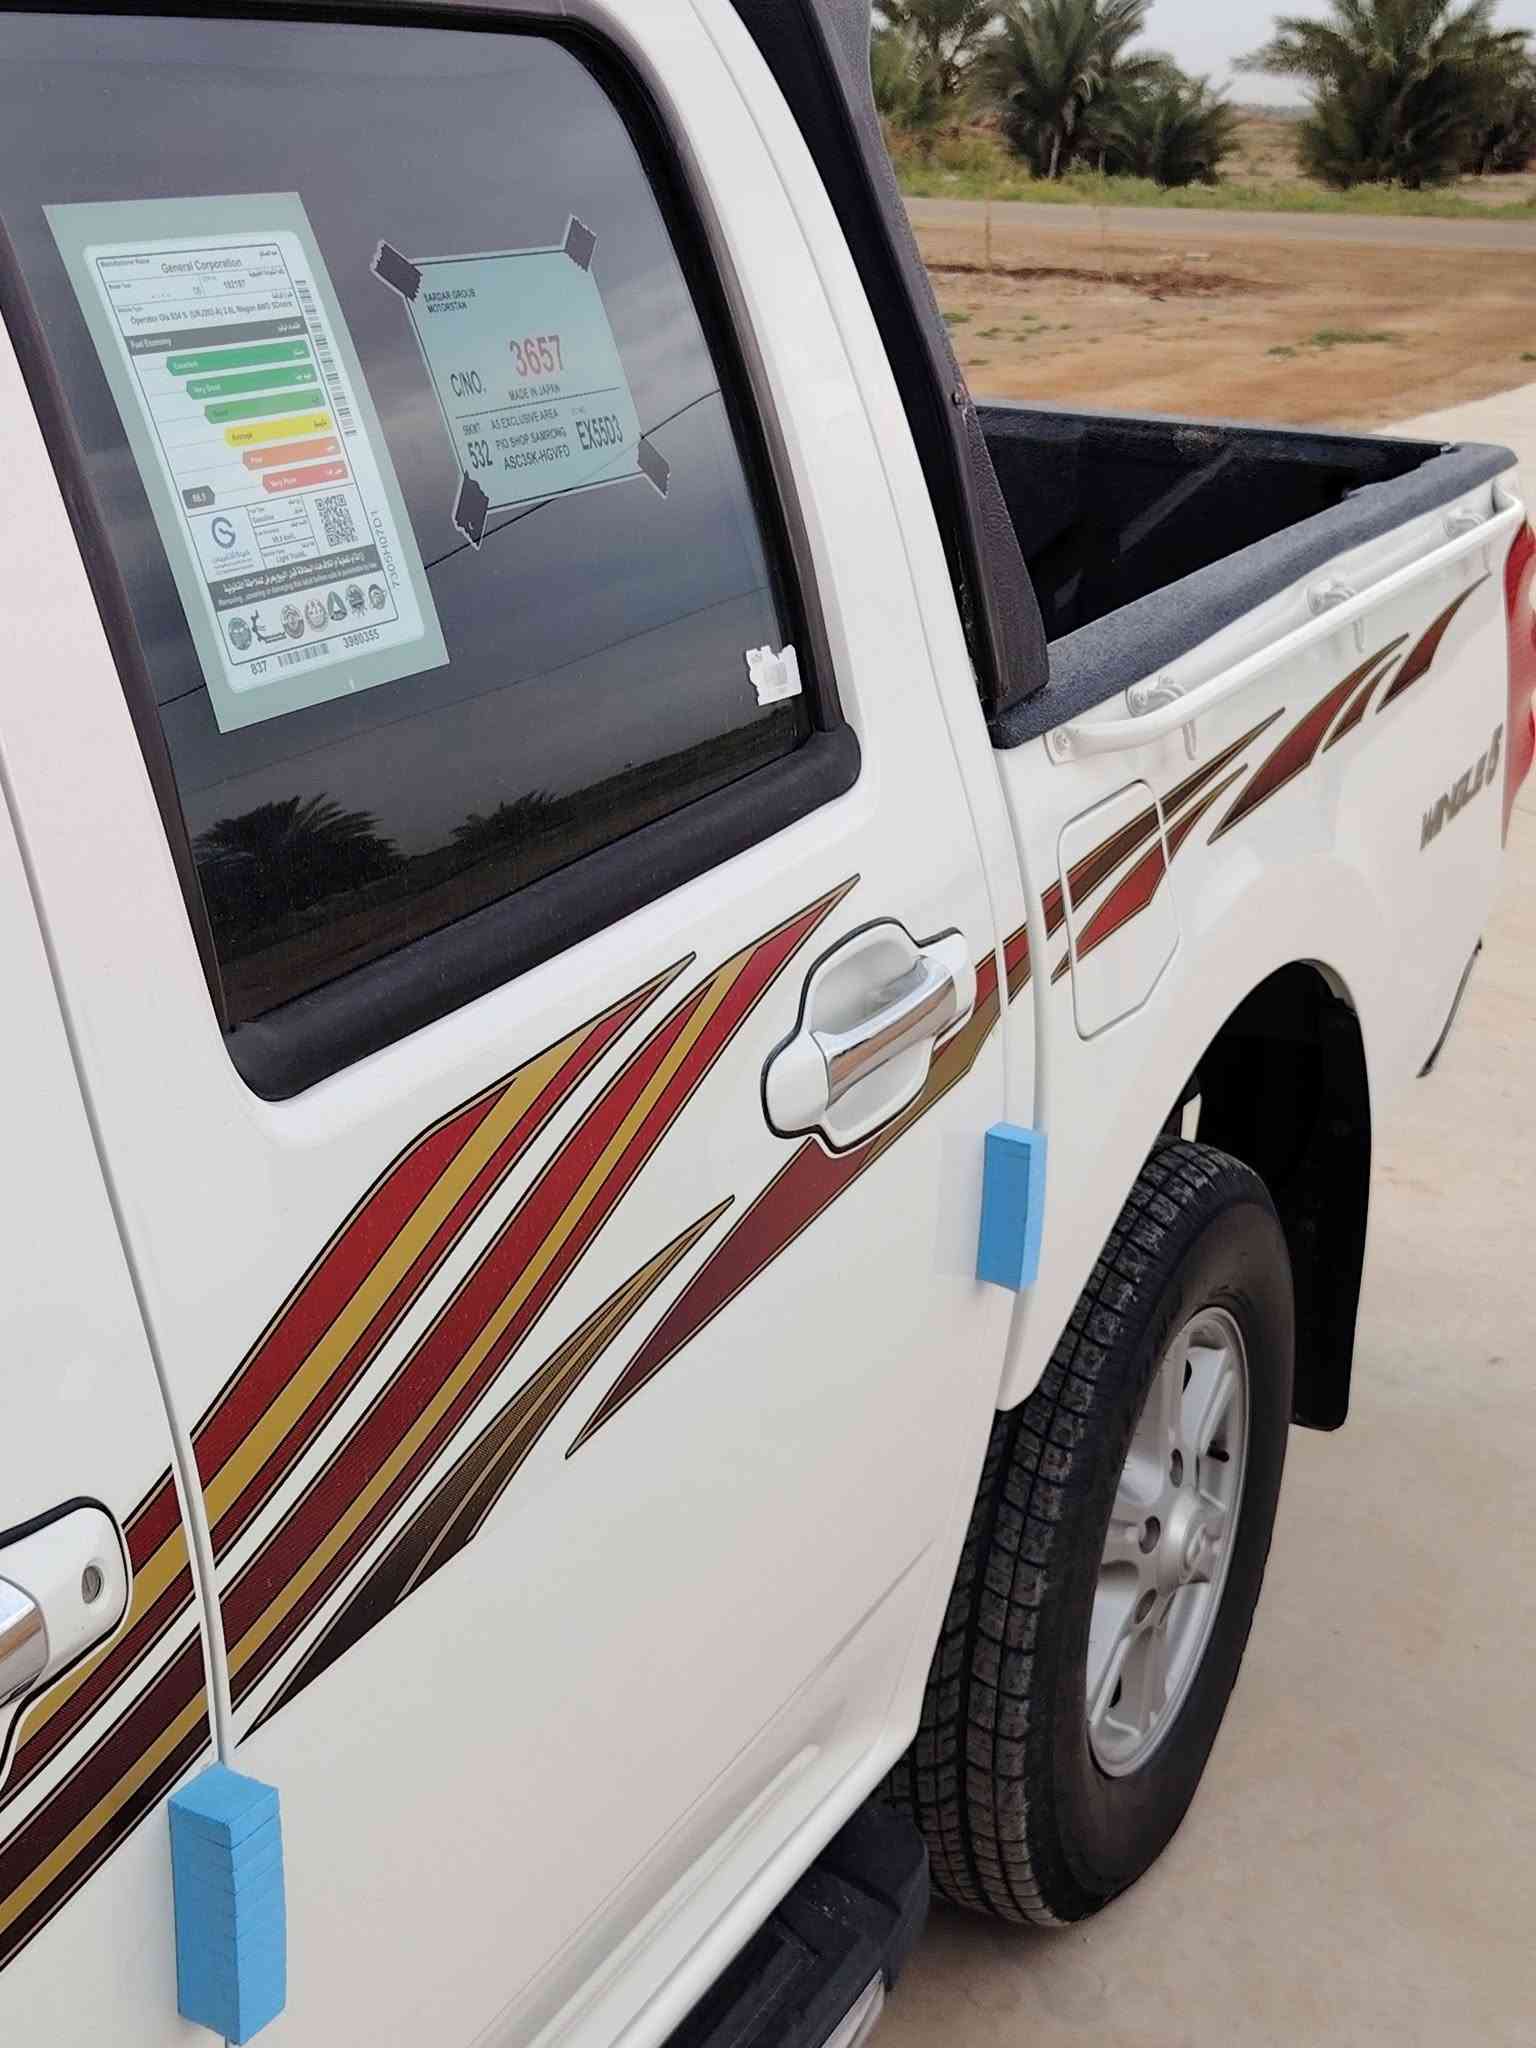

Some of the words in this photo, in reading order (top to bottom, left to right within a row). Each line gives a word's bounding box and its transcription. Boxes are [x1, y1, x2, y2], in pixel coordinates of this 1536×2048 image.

[161, 261, 193, 273] General
[194, 258, 242, 272] Corporation
[509, 334, 564, 377] 3657
[508, 387, 531, 401] MADE
[532, 387, 540, 396] IN
[540, 383, 561, 396] JAPAN
[467, 439, 494, 469] 532
[249, 660, 268, 675] 837
[342, 628, 380, 649] 3980355
